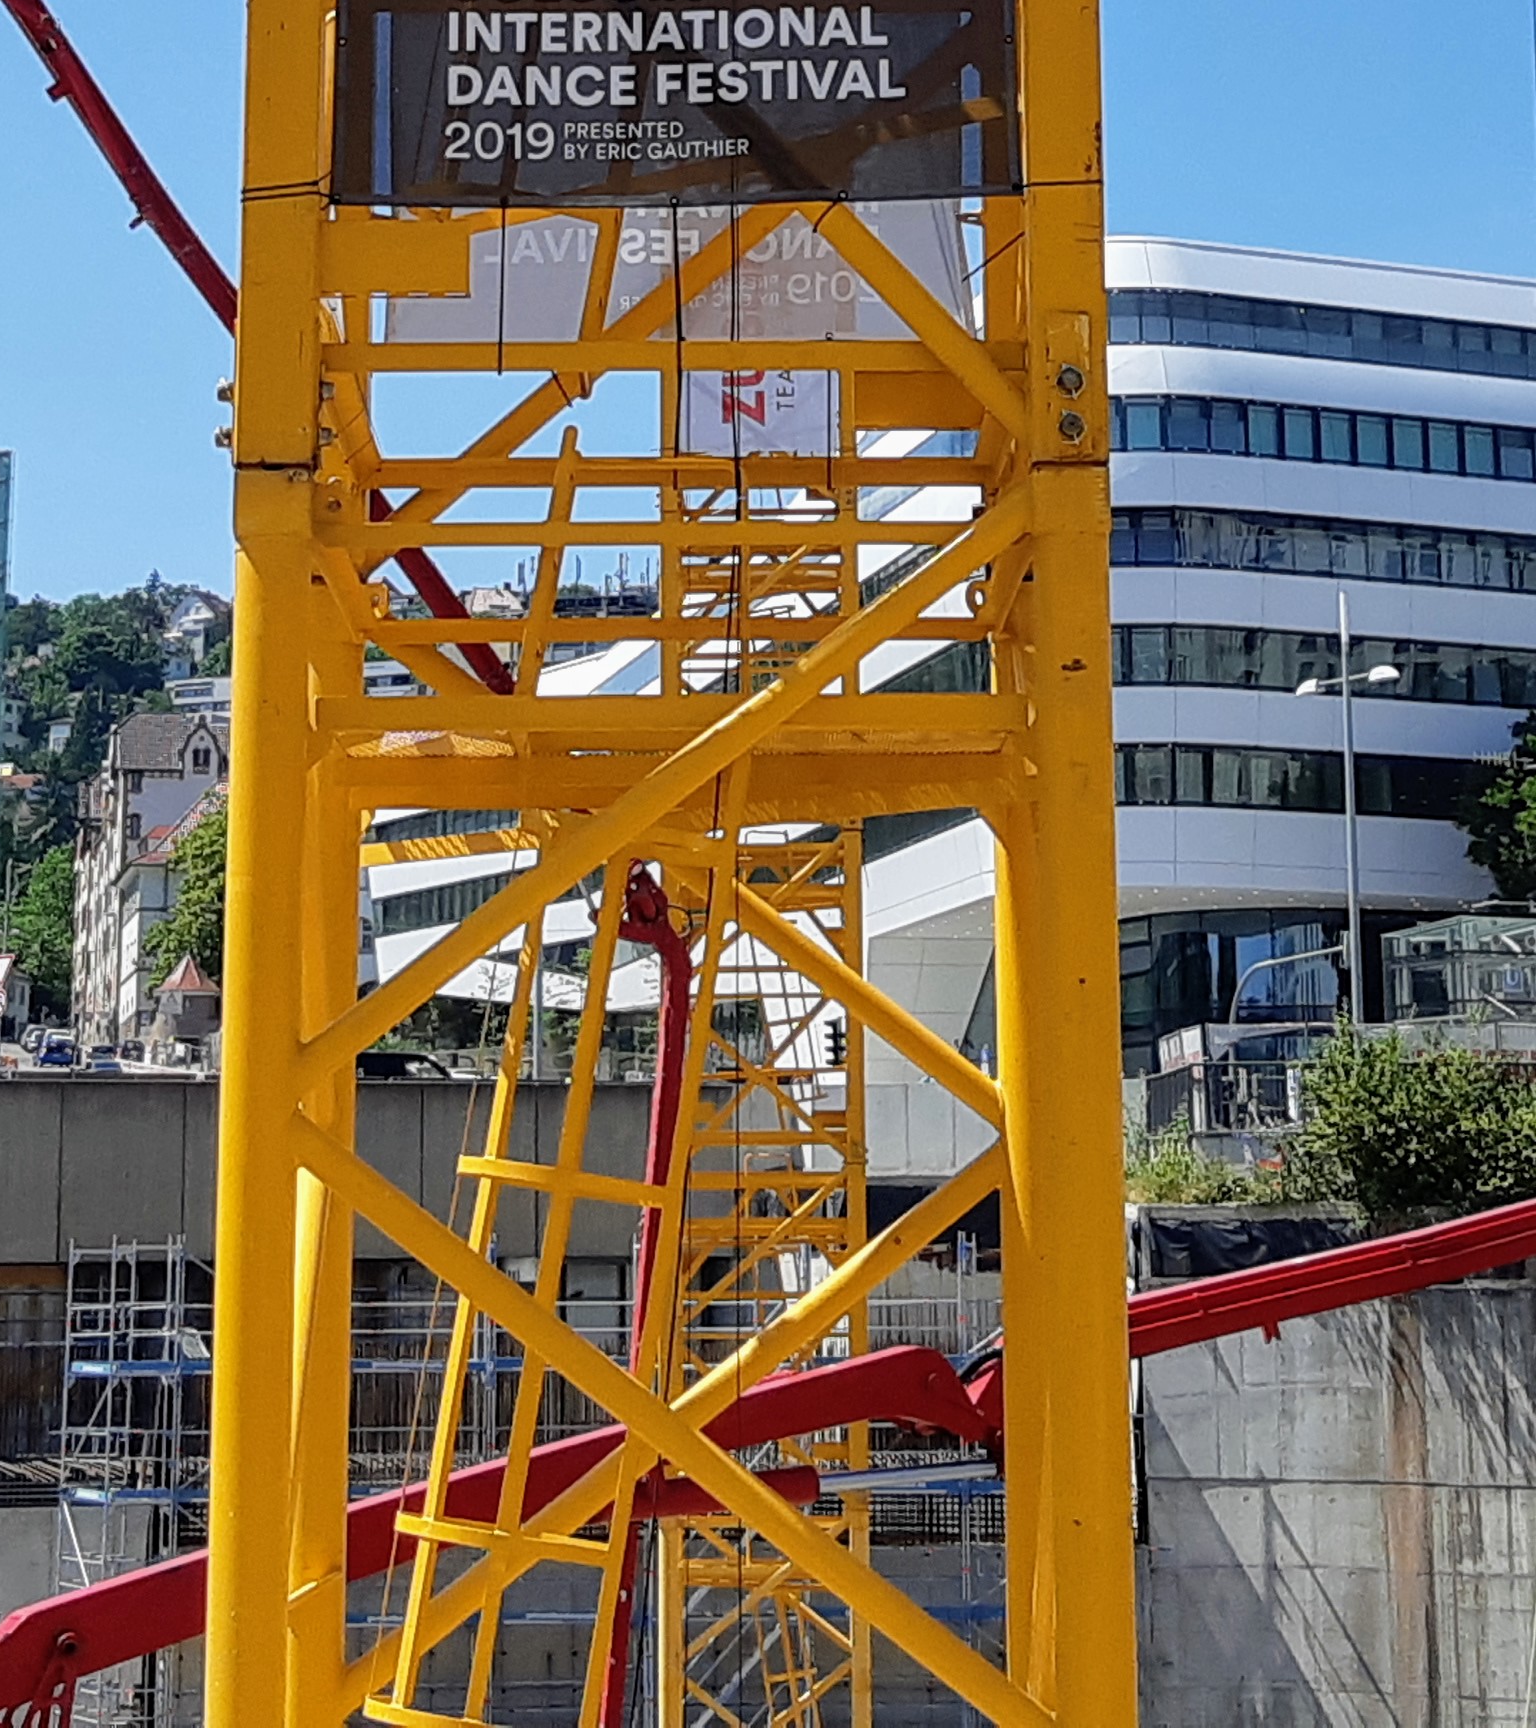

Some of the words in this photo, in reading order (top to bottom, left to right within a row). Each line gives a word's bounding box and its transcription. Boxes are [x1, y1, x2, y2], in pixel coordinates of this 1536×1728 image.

[448, 6, 889, 53] INTERNATIONAL
[447, 65, 637, 106] DANCE
[656, 58, 906, 106] FESTIVAL
[444, 121, 555, 160] 2019
[564, 121, 684, 139] PRESENTED
[564, 142, 588, 160] BY
[595, 142, 642, 160] ERIC
[646, 138, 750, 160] GAUTHIER
